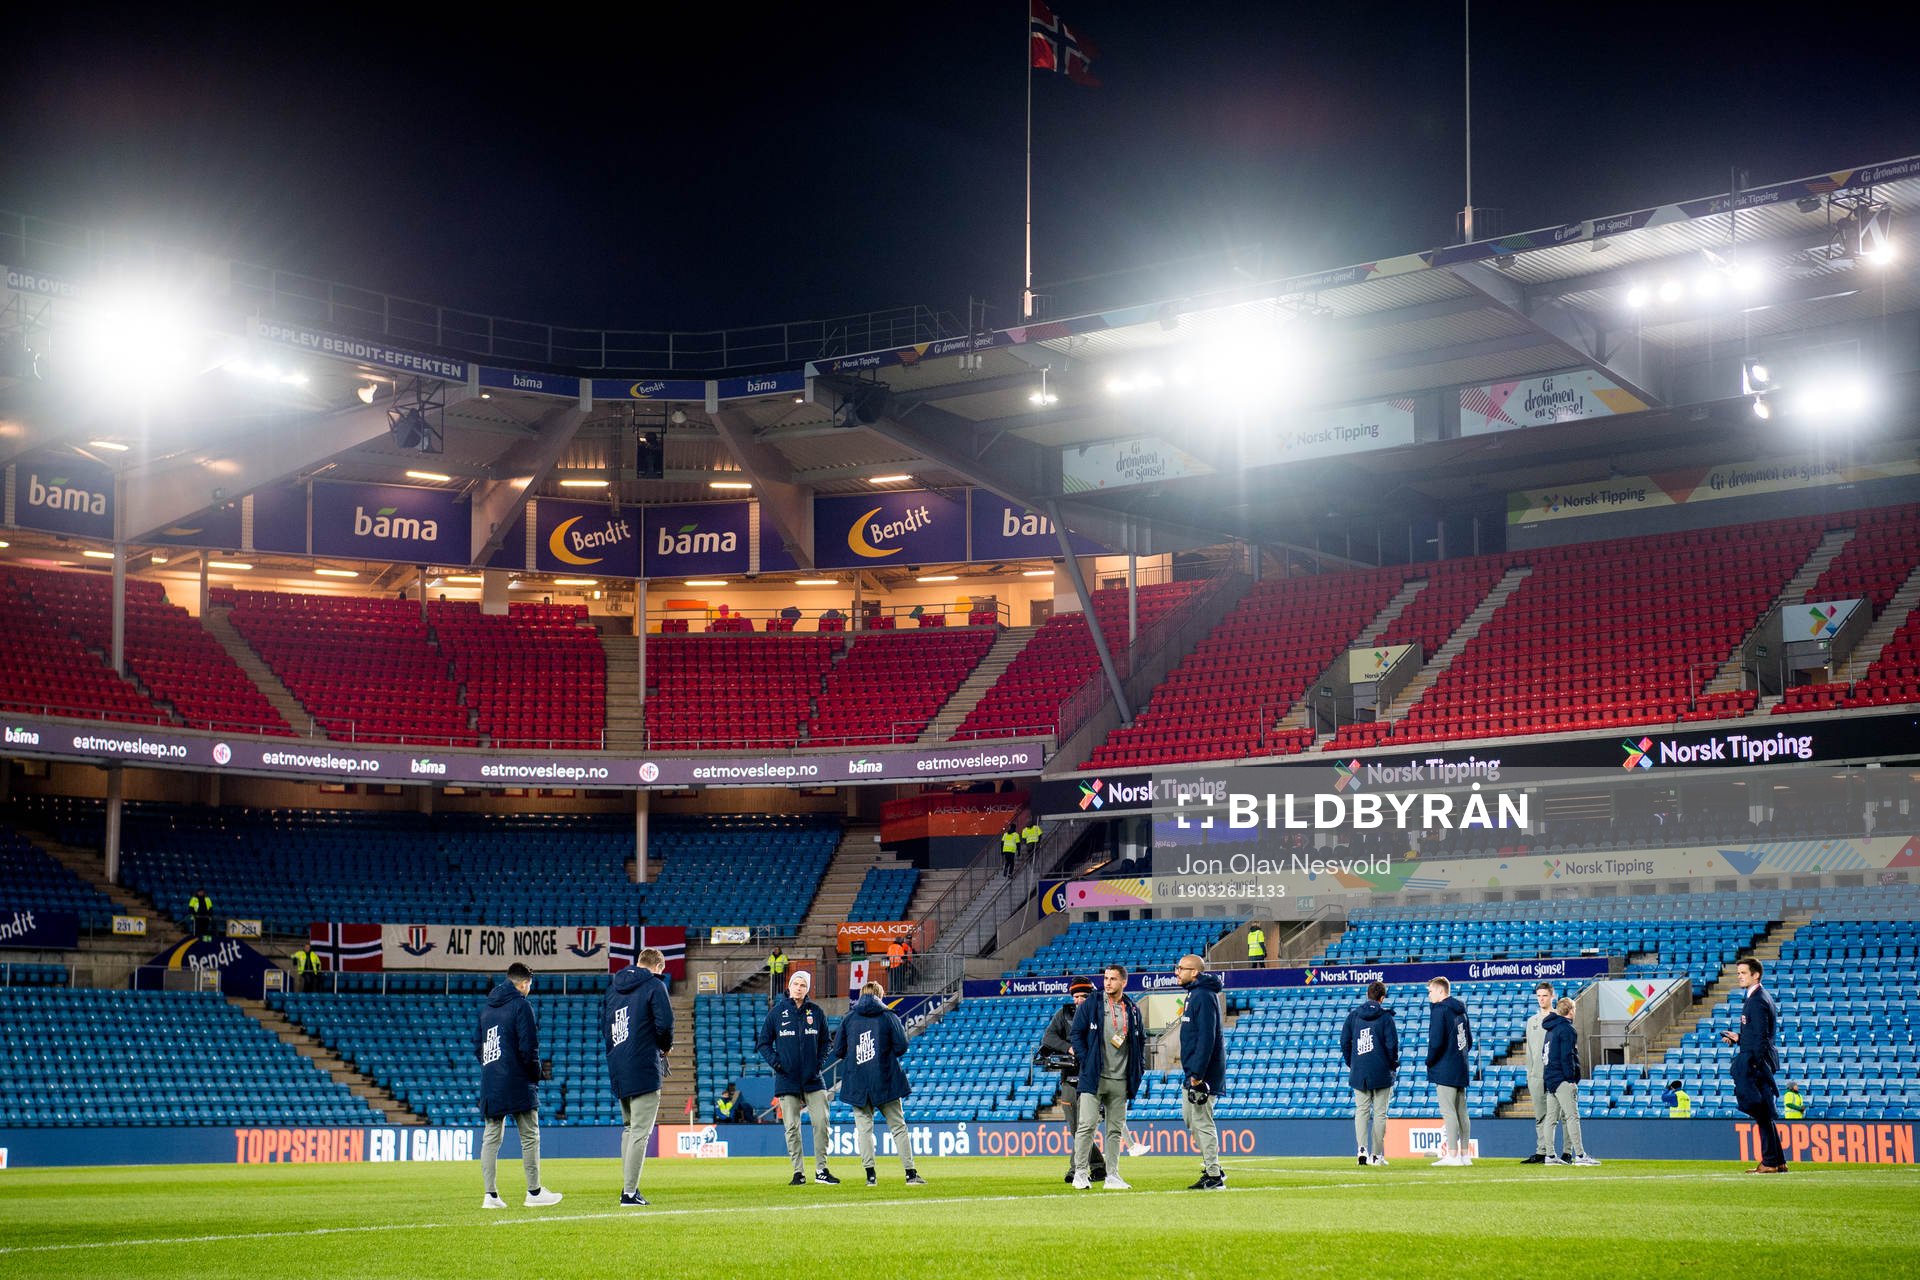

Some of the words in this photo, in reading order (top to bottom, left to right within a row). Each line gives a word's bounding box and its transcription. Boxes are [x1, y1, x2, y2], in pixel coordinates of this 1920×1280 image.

[1723, 194, 1748, 208] Nrsk
[1748, 192, 1779, 206] Tipping
[7, 272, 35, 290] GIR
[258, 323, 320, 348] OPPLEV
[322, 337, 462, 378] BENDIT-EFFEKTEN
[842, 358, 858, 369] Norsk
[512, 374, 543, 390] bama
[639, 381, 666, 395] Bendit
[747, 379, 777, 393] bama
[1542, 378, 1553, 393] Gi
[1524, 388, 1575, 413] drømmen
[1548, 395, 1584, 424] sjanse!
[1535, 410, 1546, 419] en
[1297, 428, 1333, 446] Norsk
[1334, 423, 1380, 441] Tipping
[1710, 473, 1725, 491] Gi
[1728, 466, 1779, 489] drømmen
[29, 474, 106, 516] bama
[1563, 492, 1599, 509] Norsk
[1600, 488, 1646, 506] Tipping
[354, 506, 438, 542] bama
[870, 506, 932, 545] Bendit
[571, 519, 632, 552] Bendit
[657, 527, 737, 555] bama
[4, 727, 40, 745] bama
[73, 735, 187, 759] eatmovesleep.no
[1660, 738, 1725, 764] Norsk
[1727, 732, 1813, 762] Tipping
[262, 752, 380, 773] eatmovesleep.no
[411, 759, 446, 775] bama
[848, 759, 883, 774] bama
[916, 752, 1029, 772] eatmovesleep.no
[1367, 760, 1424, 785] Norsk
[1425, 756, 1501, 784] Tipping
[480, 762, 609, 781] eatmovesleep.no
[692, 763, 818, 780] eatmovesleep.no
[1108, 780, 1159, 803] Norsk
[1160, 776, 1227, 803] Tipping
[933, 805, 980, 815] ARENA
[1565, 860, 1604, 875] Norsk
[1604, 858, 1654, 876] Tipping
[1157, 880, 1169, 896] Gi
[0, 910, 37, 941] ndit
[117, 921, 131, 932] 231
[838, 925, 887, 935] ARENA
[446, 928, 473, 955] ALT
[480, 929, 506, 956] FOR
[514, 929, 558, 955] NORGE
[188, 939, 243, 972] Bendit
[1320, 969, 1348, 982] Norsk
[1348, 968, 1384, 982] Tipping
[1468, 963, 1481, 978] Gi
[1482, 962, 1519, 978] drømmen
[1521, 963, 1533, 975] en
[1533, 960, 1566, 978] sjanse!
[1013, 982, 1038, 993] Norsk
[1038, 980, 1069, 994] Tipping
[1142, 975, 1153, 989] Gi
[615, 1006, 629, 1022] EAT
[486, 1025, 499, 1041] EAT
[611, 1016, 630, 1037] MOVE
[779, 1029, 796, 1037] bama
[483, 1035, 501, 1055] MOVE
[612, 1031, 630, 1047] SLEEP
[859, 1030, 872, 1042] EAT
[856, 1038, 875, 1056] MOVE
[482, 1049, 501, 1066] SLEEP
[856, 1050, 876, 1065] SLEEP
[235, 1129, 364, 1165] TOPPSERIEN
[369, 1128, 396, 1162] ER
[400, 1129, 408, 1162] I
[412, 1129, 474, 1162] GANG!
[680, 1135, 702, 1152] TOPP
[883, 1126, 934, 1155] ntt
[939, 1122, 970, 1157] på
[977, 1122, 1256, 1157] toppfotakvinne.no
[1412, 1132, 1442, 1149] TOPP
